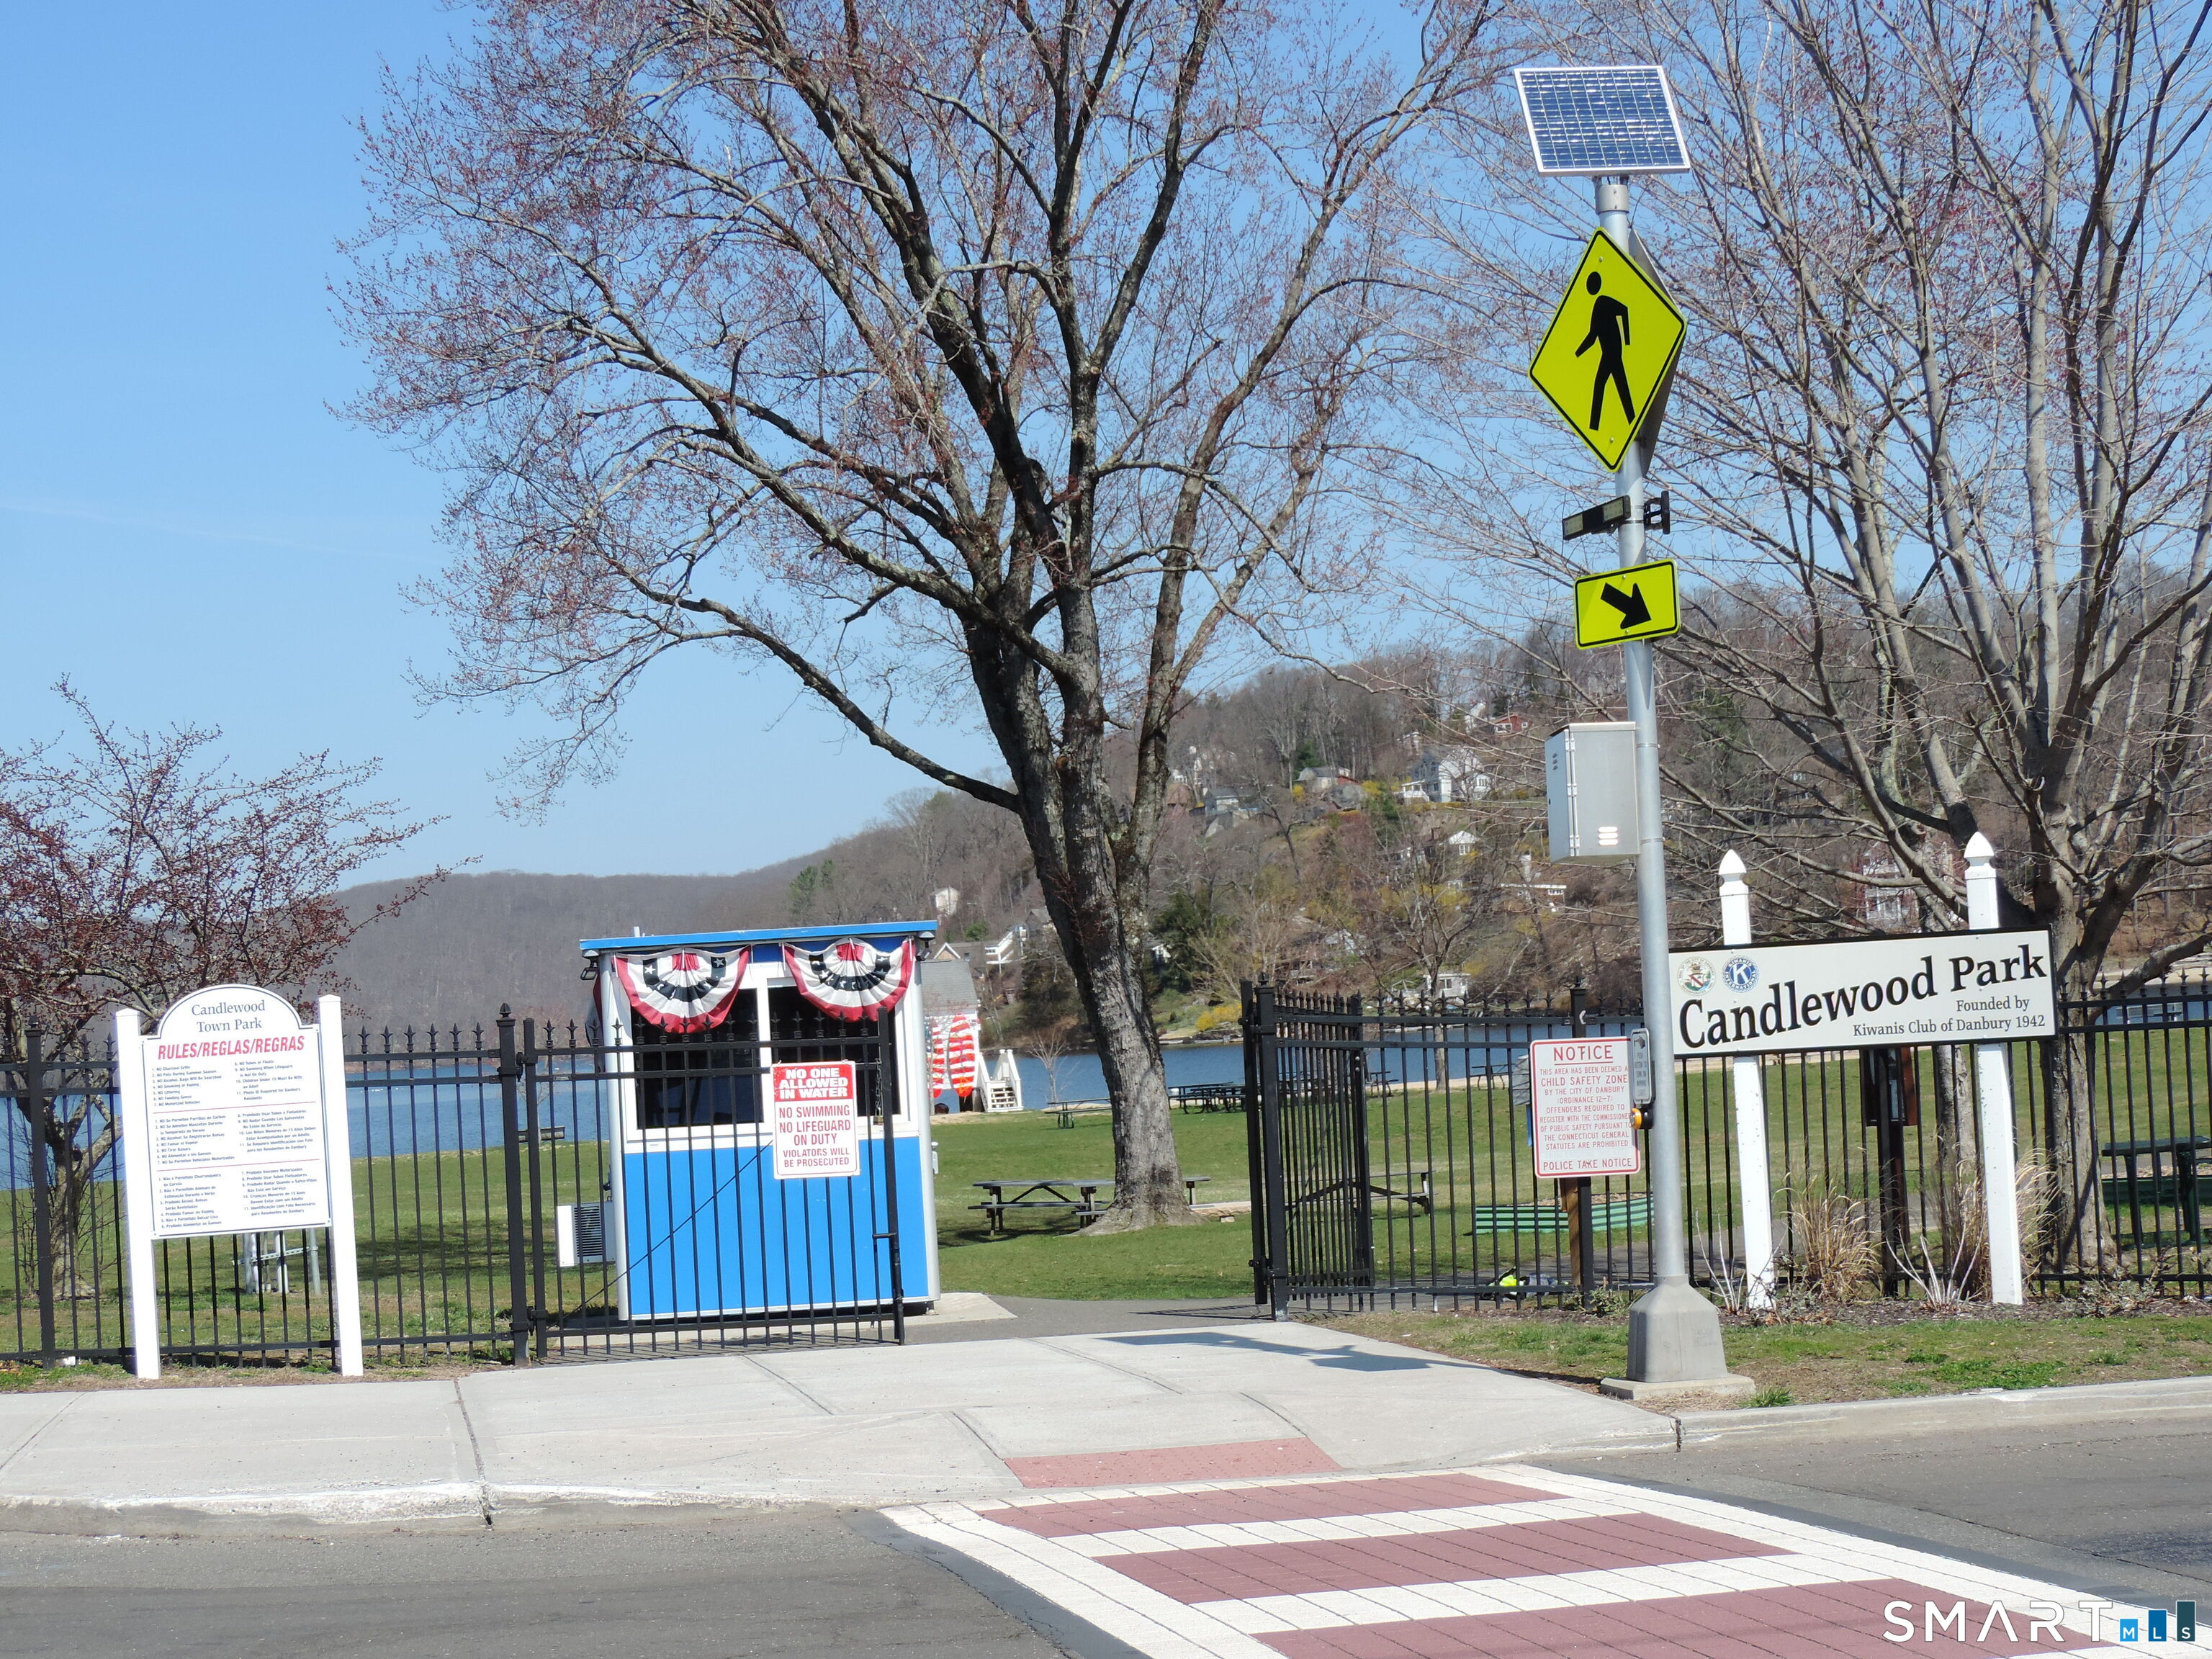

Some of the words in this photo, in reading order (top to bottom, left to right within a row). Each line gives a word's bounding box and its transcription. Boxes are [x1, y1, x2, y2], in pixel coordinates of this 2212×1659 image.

[1725, 971, 1755, 989] INTERNATIONAL
[1732, 964, 1749, 984] K
[1680, 956, 1938, 1048] Candlewood
[1949, 945, 2046, 992] Park
[192, 1000, 265, 1015] Candlewood
[1956, 997, 2011, 1012] Founded
[2015, 995, 2029, 1012] by
[197, 1021, 230, 1032] Town
[235, 1017, 262, 1030] Park
[1853, 1022, 1904, 1036] Kiwanis
[1909, 1020, 1937, 1033] Club
[1941, 1019, 1954, 1031] of
[1956, 1016, 2011, 1034] Danbury
[2015, 1015, 2045, 1028] 1942
[158, 1036, 305, 1059] RULES/REGLAS/REGRAS
[1554, 1045, 1613, 1061] NOTICE
[786, 1069, 806, 1079] NO
[810, 1068, 840, 1077] ONE
[1542, 1077, 1565, 1086] CHILD
[1570, 1076, 1600, 1085] SAFETY
[1606, 1074, 1627, 1083] ZONE
[779, 1077, 848, 1089] ALLOWED
[780, 1089, 795, 1099] IN
[799, 1087, 848, 1098] WATER
[779, 1107, 792, 1118] NO
[797, 1105, 850, 1118] SWIMMING
[780, 1122, 792, 1133] NO
[797, 1120, 850, 1132] LIFEGUARD
[794, 1135, 806, 1146] ON
[811, 1133, 837, 1145] DUTY
[783, 1148, 827, 1158] VIOLATORS
[797, 1157, 849, 1166] PROSECUTED
[1544, 1161, 1573, 1170] POLICE
[1578, 1159, 1598, 1169] TAKE
[1602, 1158, 1632, 1167] NOTICE
